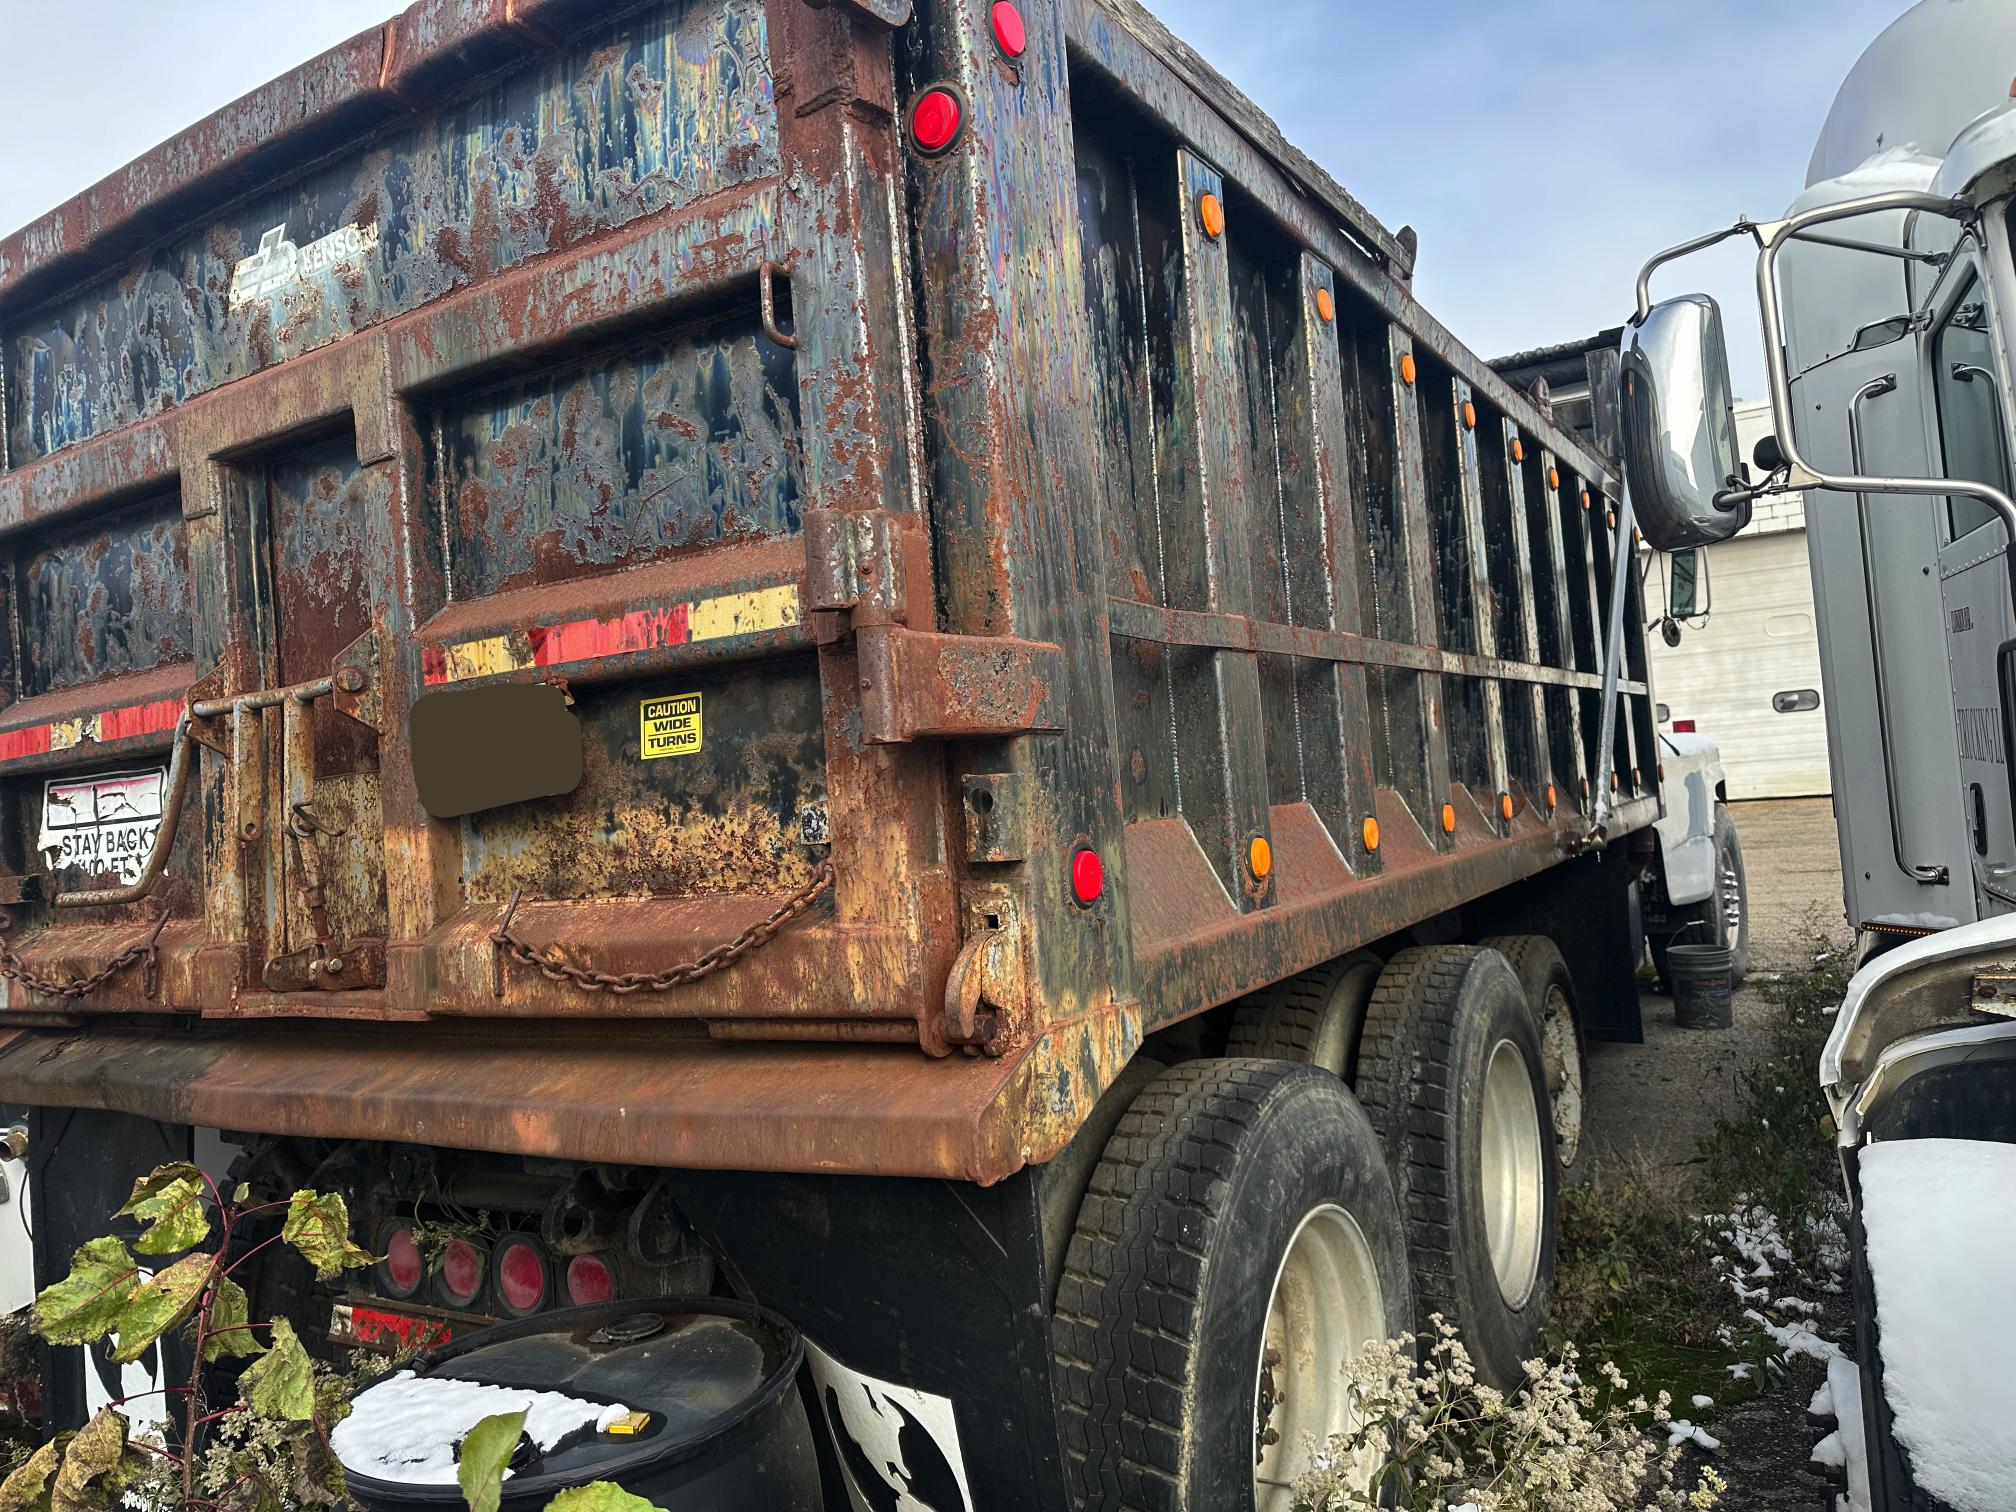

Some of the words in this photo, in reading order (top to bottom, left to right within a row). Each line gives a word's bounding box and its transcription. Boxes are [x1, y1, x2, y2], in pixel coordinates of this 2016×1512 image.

[648, 699, 697, 718] CAUTION
[653, 717, 691, 732] WIDE
[648, 733, 697, 748] TURNS
[1957, 707, 1993, 763] TRUCKING
[62, 832, 100, 856] STAY
[106, 827, 149, 853] BACK
